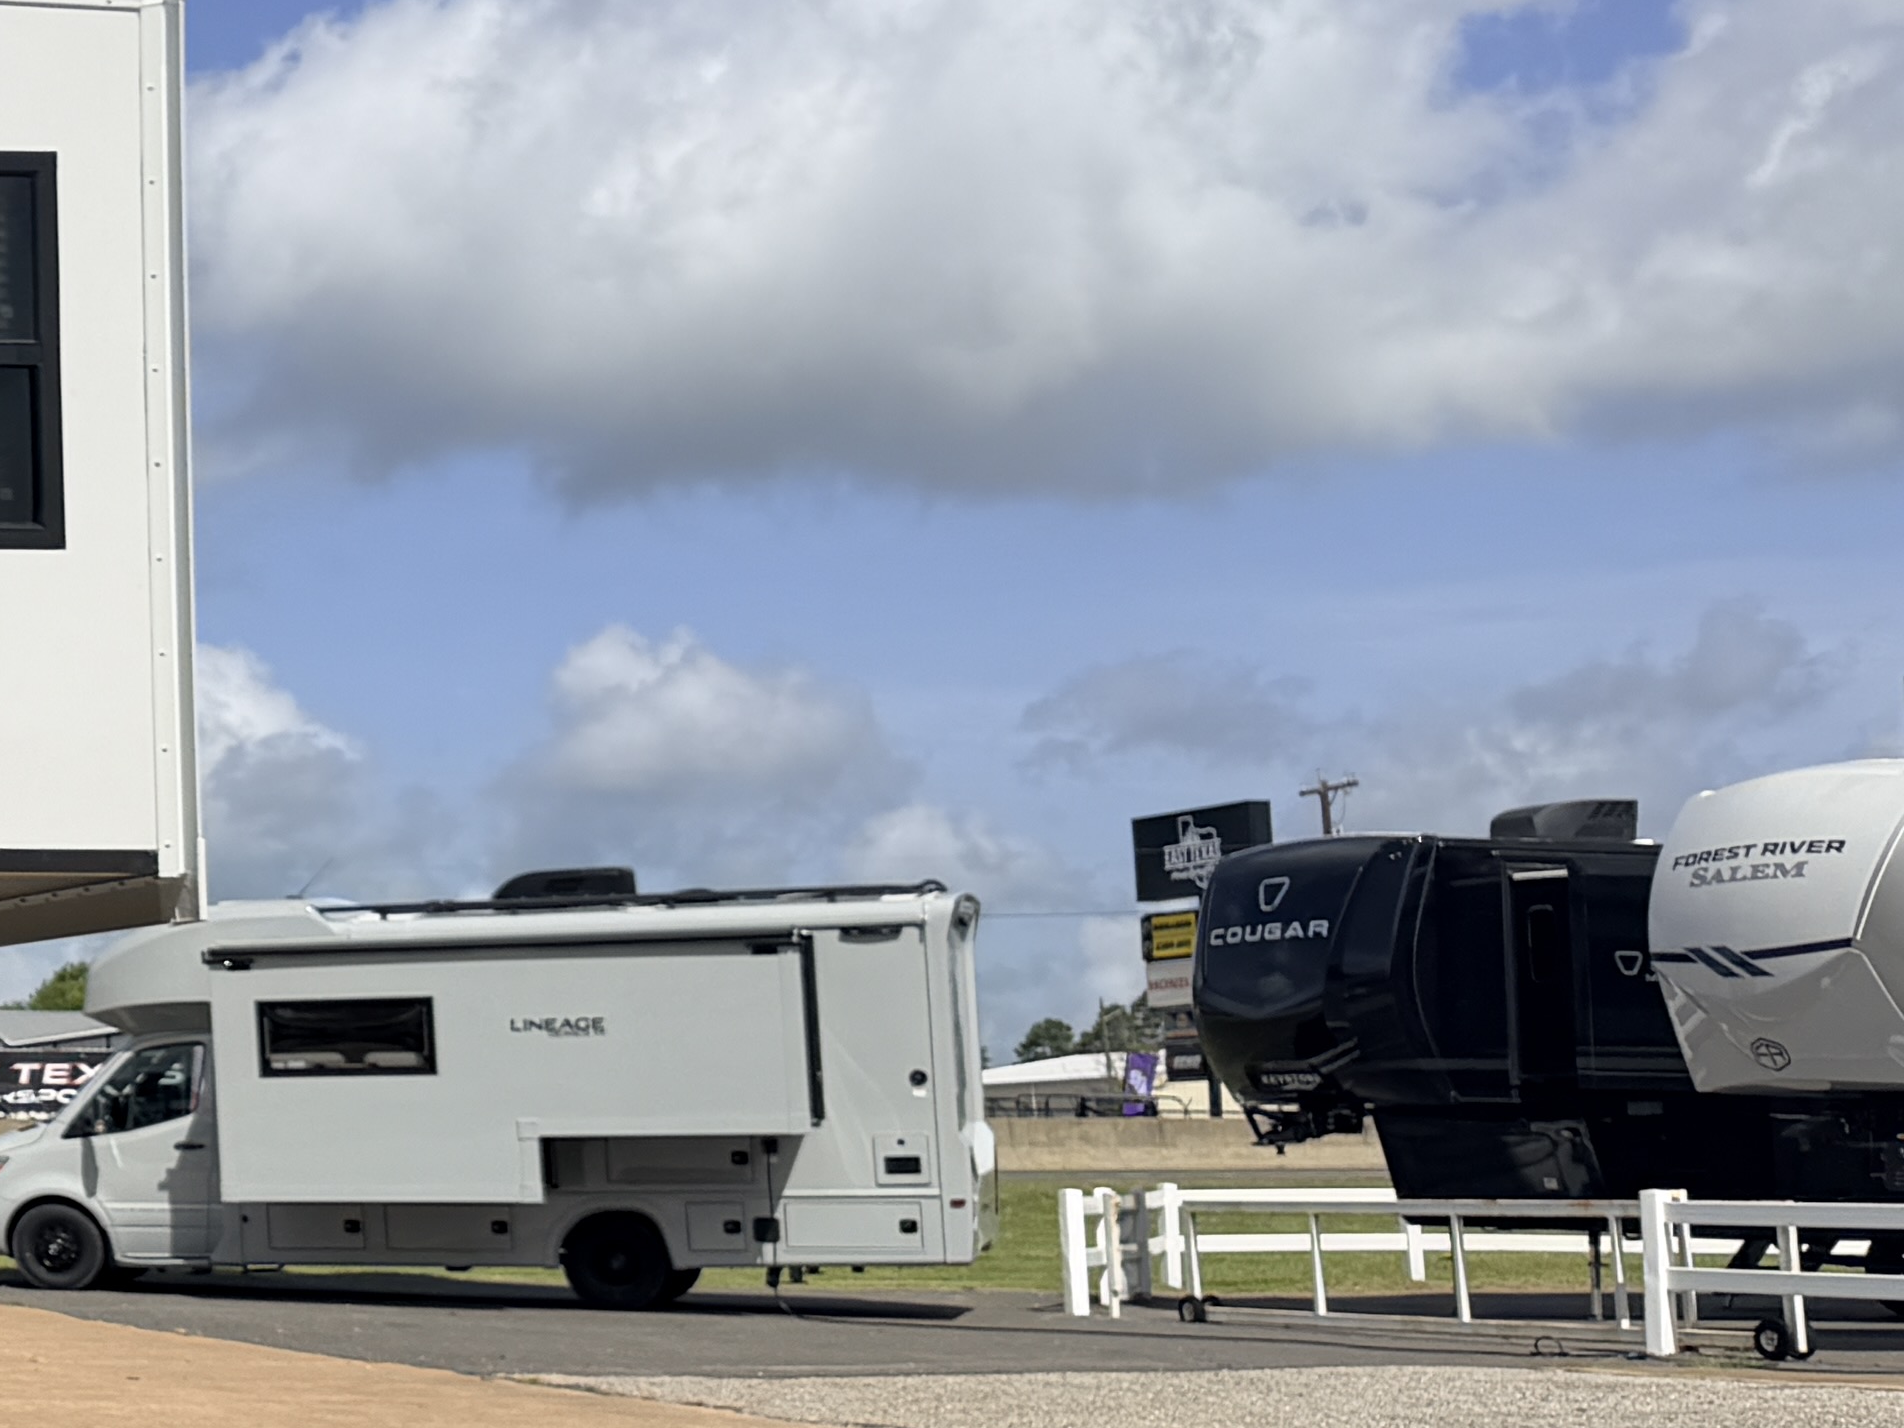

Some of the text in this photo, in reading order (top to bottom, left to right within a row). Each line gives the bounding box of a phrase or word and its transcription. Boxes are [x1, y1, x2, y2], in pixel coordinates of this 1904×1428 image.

[1672, 839, 1846, 871] FOREST RIVER
[1689, 860, 1809, 888] SALEM
[1210, 919, 1329, 946] COUGAR
[509, 1017, 605, 1035] LINEAGE
